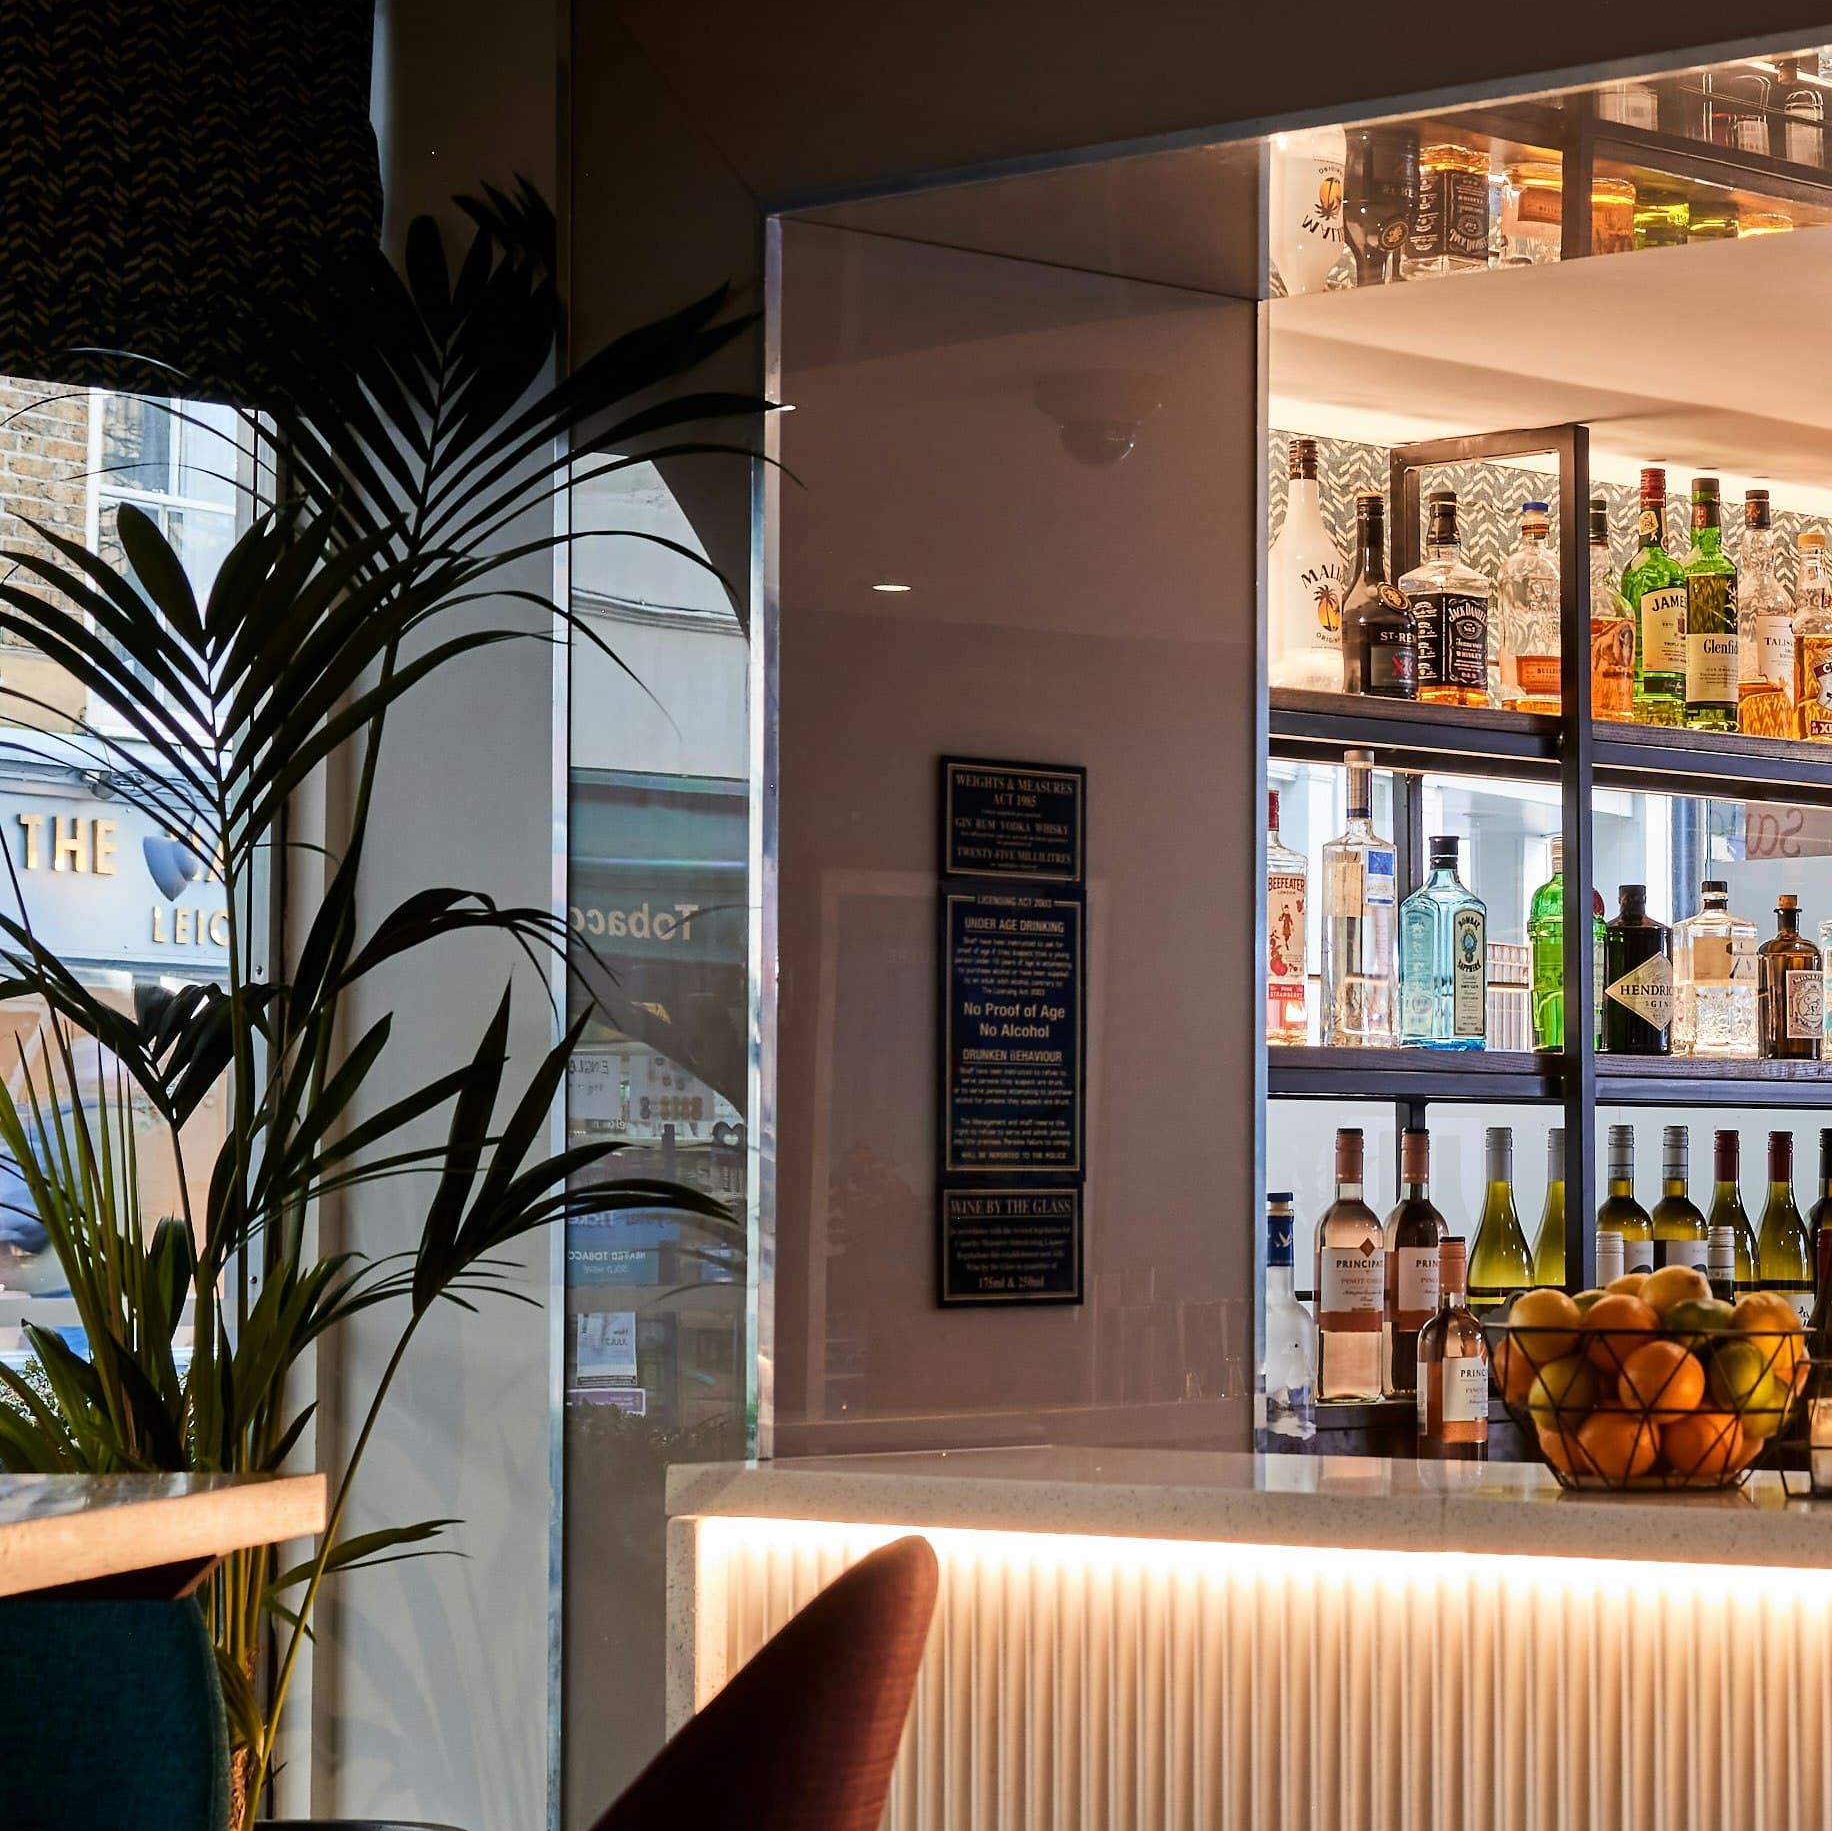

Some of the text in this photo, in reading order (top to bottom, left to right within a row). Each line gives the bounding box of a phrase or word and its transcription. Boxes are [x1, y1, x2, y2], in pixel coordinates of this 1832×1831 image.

[955, 774, 1004, 790] WEIGHTS
[1017, 779, 1073, 794] MEASURES
[992, 793, 1013, 806] ACT
[955, 818, 1069, 835] GIN RUM VODKA WHISKY
[17, 813, 120, 875] THE
[1268, 876, 1304, 893] BEEFEATER
[964, 917, 1064, 933] UNDER AGE DRINKING
[1458, 916, 1481, 930] BOMBAY
[1457, 959, 1482, 973] SAPPHIRE
[963, 1002, 1065, 1020] No Proof of Age
[979, 1023, 1050, 1038] No Alcohol
[962, 1048, 1063, 1062] DRUNKEN BEHAVIOUR
[951, 1199, 1072, 1214] WINE BY THE GLASS
